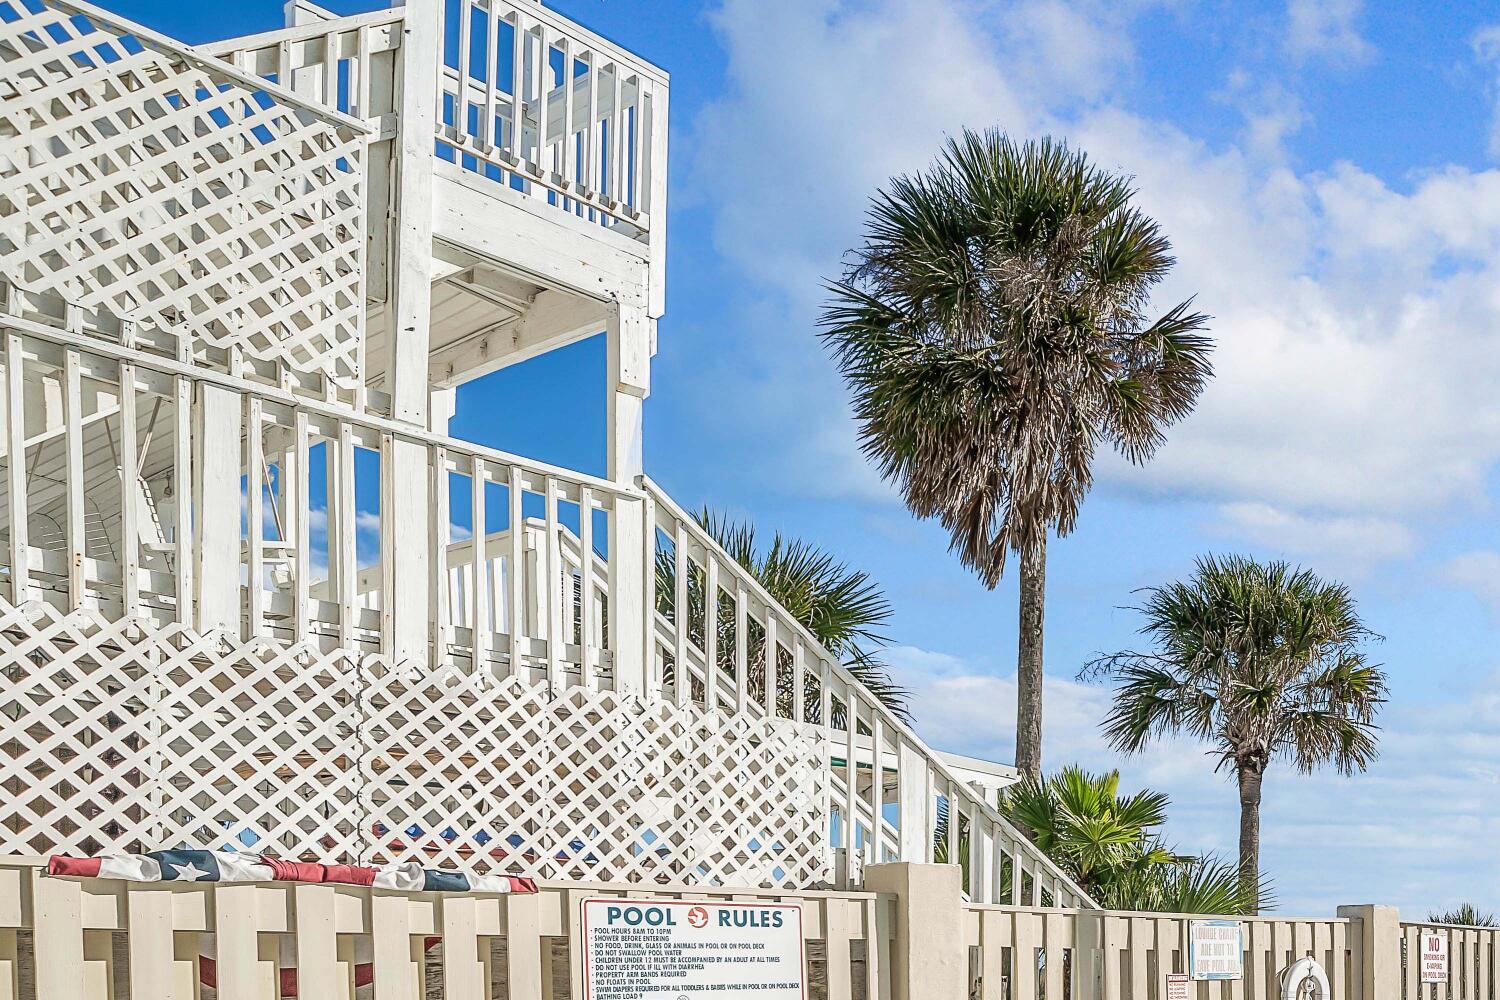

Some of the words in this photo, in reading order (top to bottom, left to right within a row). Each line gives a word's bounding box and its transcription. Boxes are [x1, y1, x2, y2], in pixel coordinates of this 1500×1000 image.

[607, 906, 677, 926] POOL
[718, 909, 784, 928] RULES
[1428, 937, 1440, 952] NO
